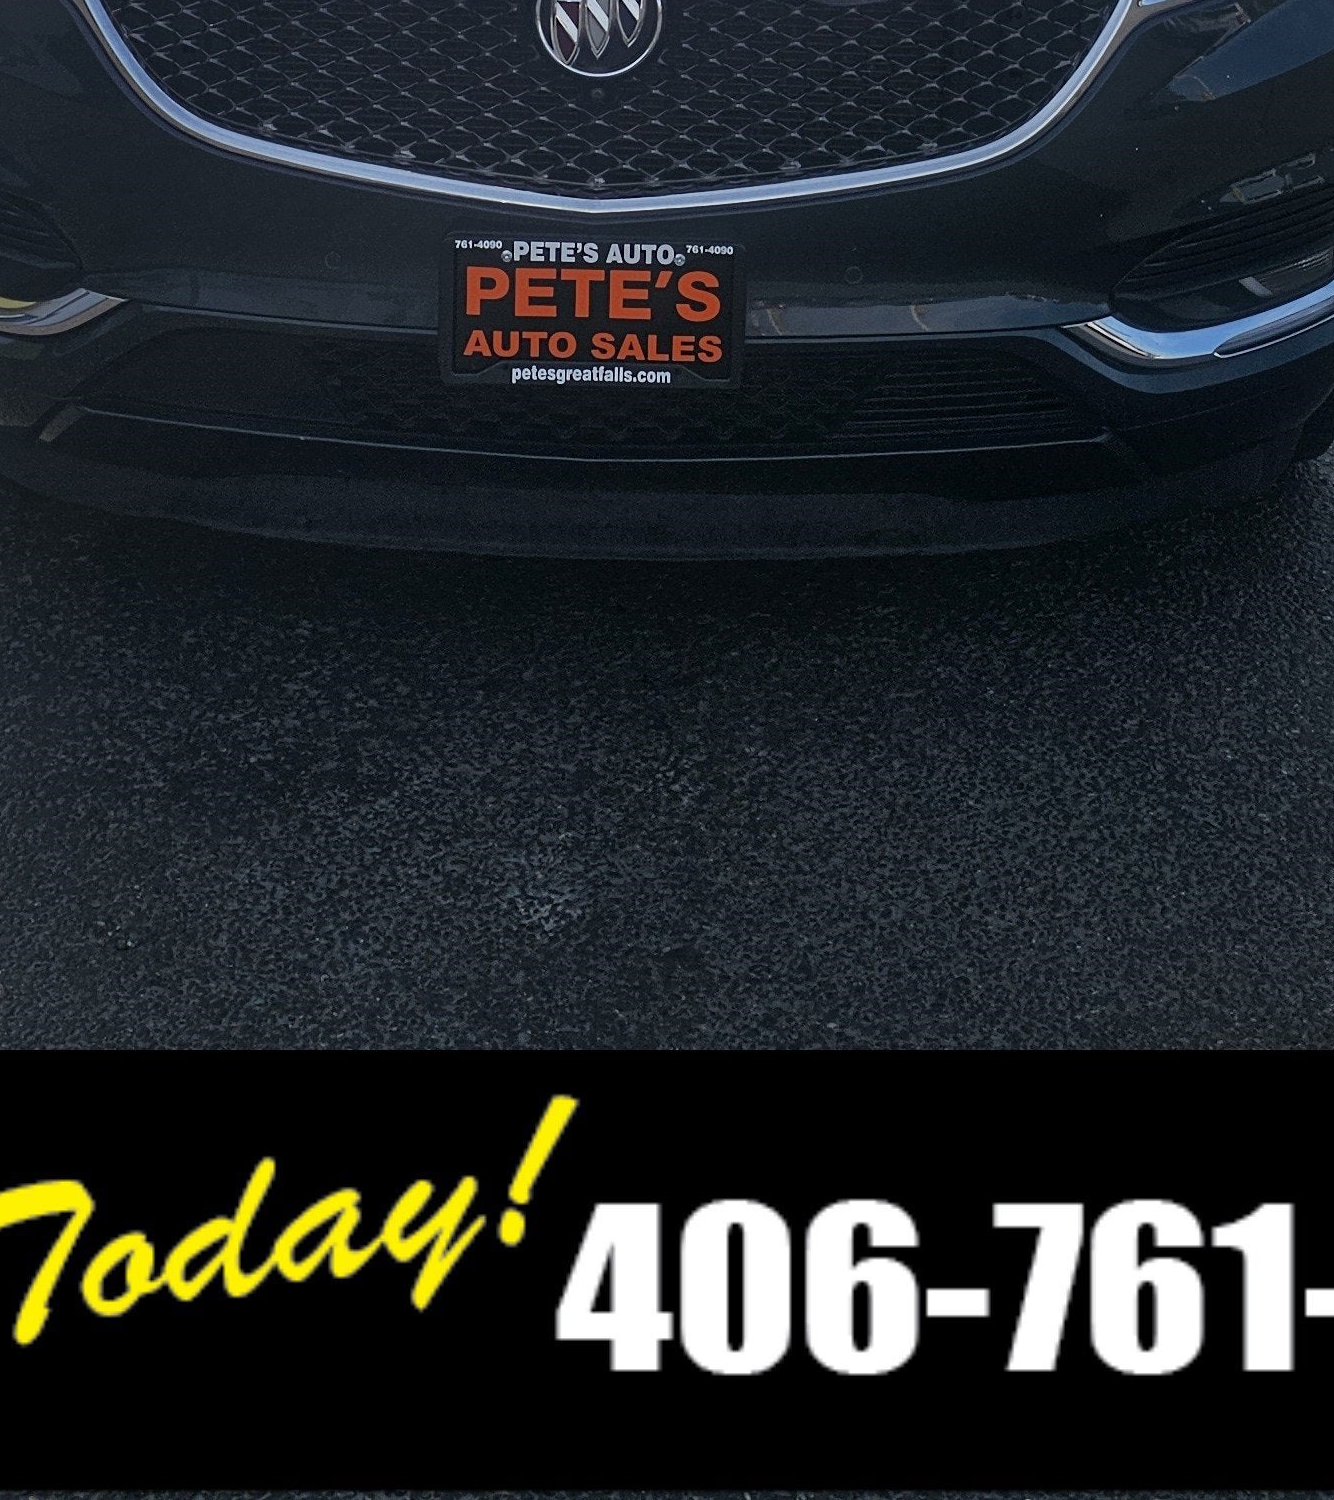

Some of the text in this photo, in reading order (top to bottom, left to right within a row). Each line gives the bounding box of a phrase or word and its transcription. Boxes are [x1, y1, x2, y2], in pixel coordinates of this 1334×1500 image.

[455, 240, 502, 250] 761-4090
[513, 241, 675, 265] PETE'S AUTO
[686, 245, 734, 255] 761-4090
[466, 266, 721, 322] PETE'S
[463, 329, 723, 363] AUTO SALES
[512, 365, 671, 385] petesgreatfalls.com
